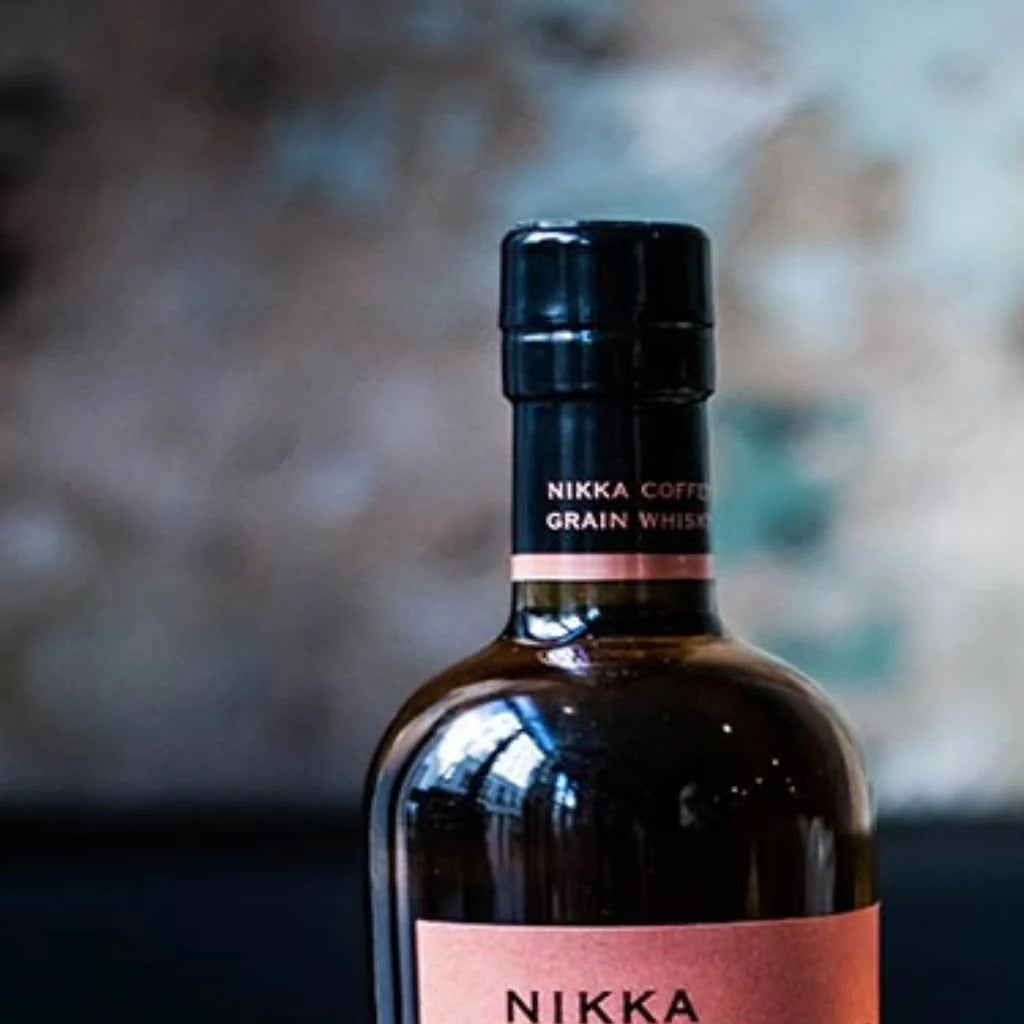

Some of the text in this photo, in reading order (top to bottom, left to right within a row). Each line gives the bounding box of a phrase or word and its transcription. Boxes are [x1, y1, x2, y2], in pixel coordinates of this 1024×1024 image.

[546, 481, 710, 501] NIKKA COFFE
[545, 510, 711, 531] GRAIN WHISK
[506, 989, 699, 1024] NIKKA
